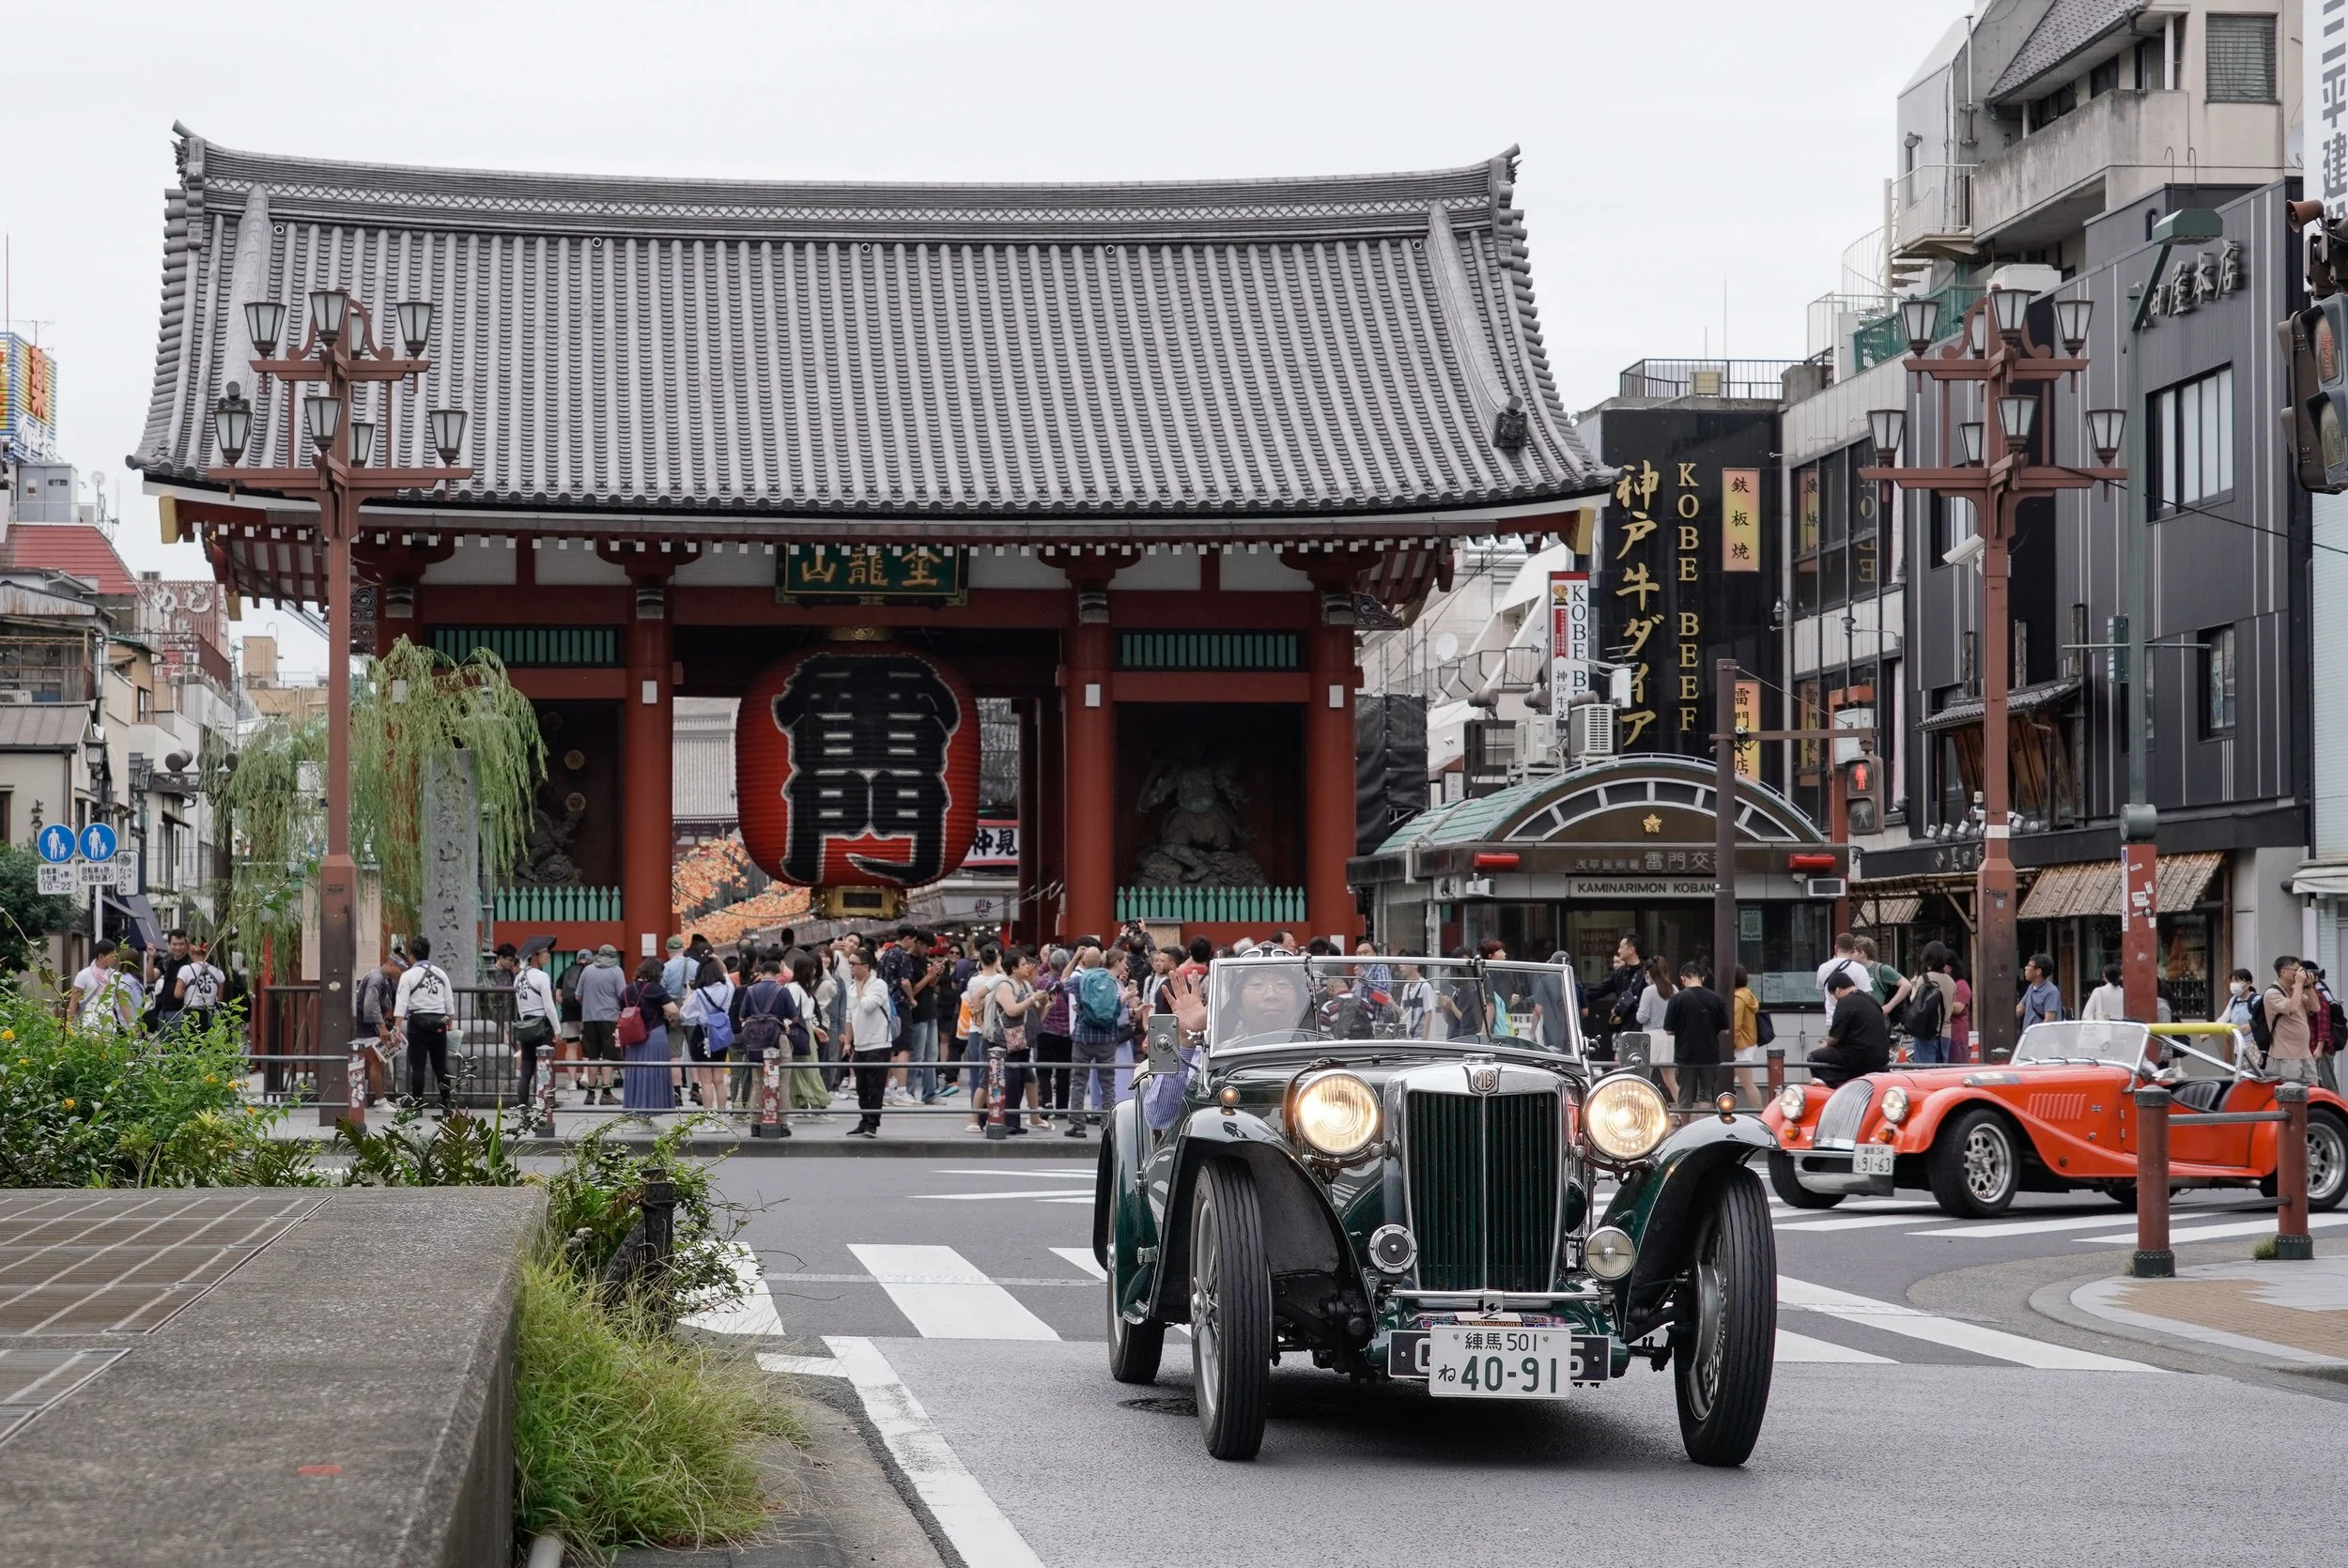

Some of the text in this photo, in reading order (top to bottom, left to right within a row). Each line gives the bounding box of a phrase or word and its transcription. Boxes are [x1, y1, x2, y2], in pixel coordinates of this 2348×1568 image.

[1731, 476, 1750, 561] 鉄板焼
[1571, 584, 1586, 660] KOBE
[1615, 459, 1664, 747] 神戸牛ダイア
[1677, 462, 1699, 731] KOBE BEEF
[772, 653, 962, 884] 雷門
[1578, 883, 1715, 893] KAMINARIMON KOBAN
[1475, 1071, 1493, 1088] MG
[1862, 1157, 1891, 1172] 91-63
[1464, 1332, 1537, 1352] 練馬 501
[1438, 1364, 1457, 1382] ね
[1460, 1356, 1557, 1393] 40-91
